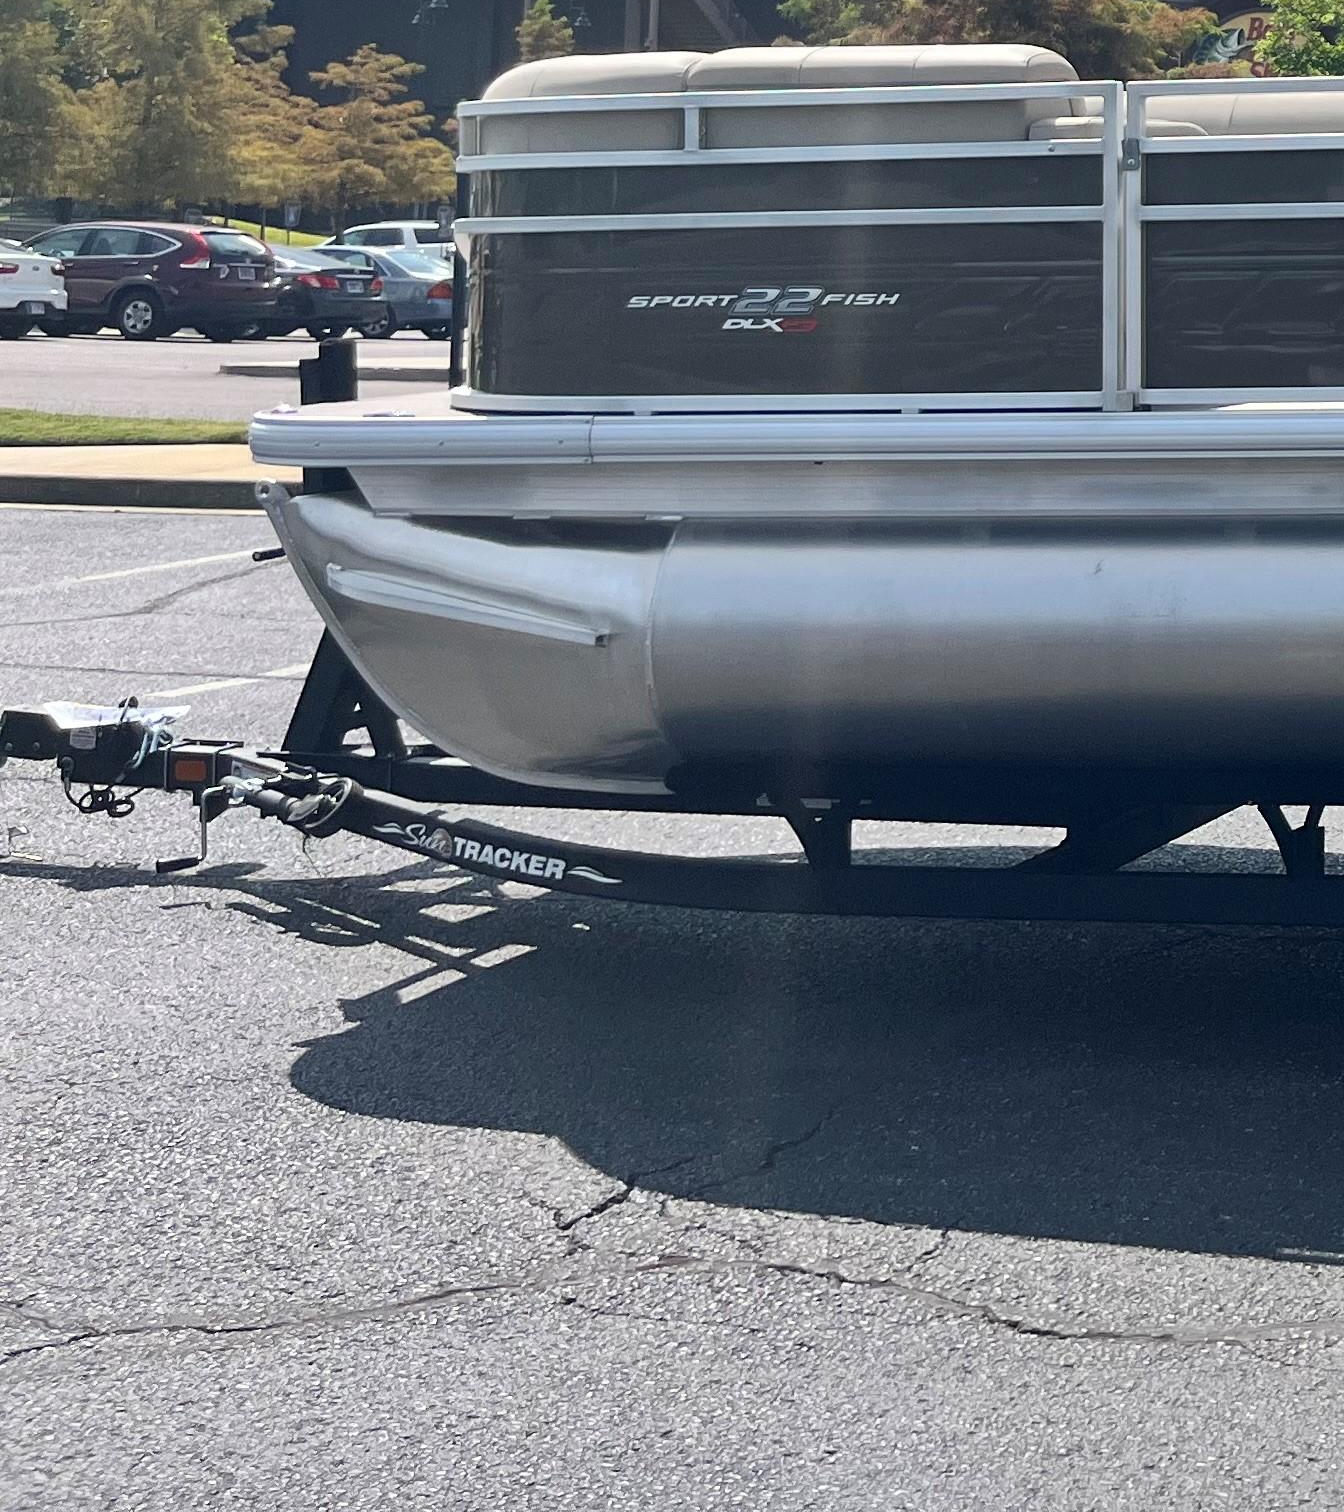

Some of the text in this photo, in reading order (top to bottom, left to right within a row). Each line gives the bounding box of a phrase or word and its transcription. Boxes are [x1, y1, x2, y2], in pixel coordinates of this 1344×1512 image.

[626, 285, 901, 315] SPORT 22 FISH
[402, 823, 567, 880] Sun TRACKER
